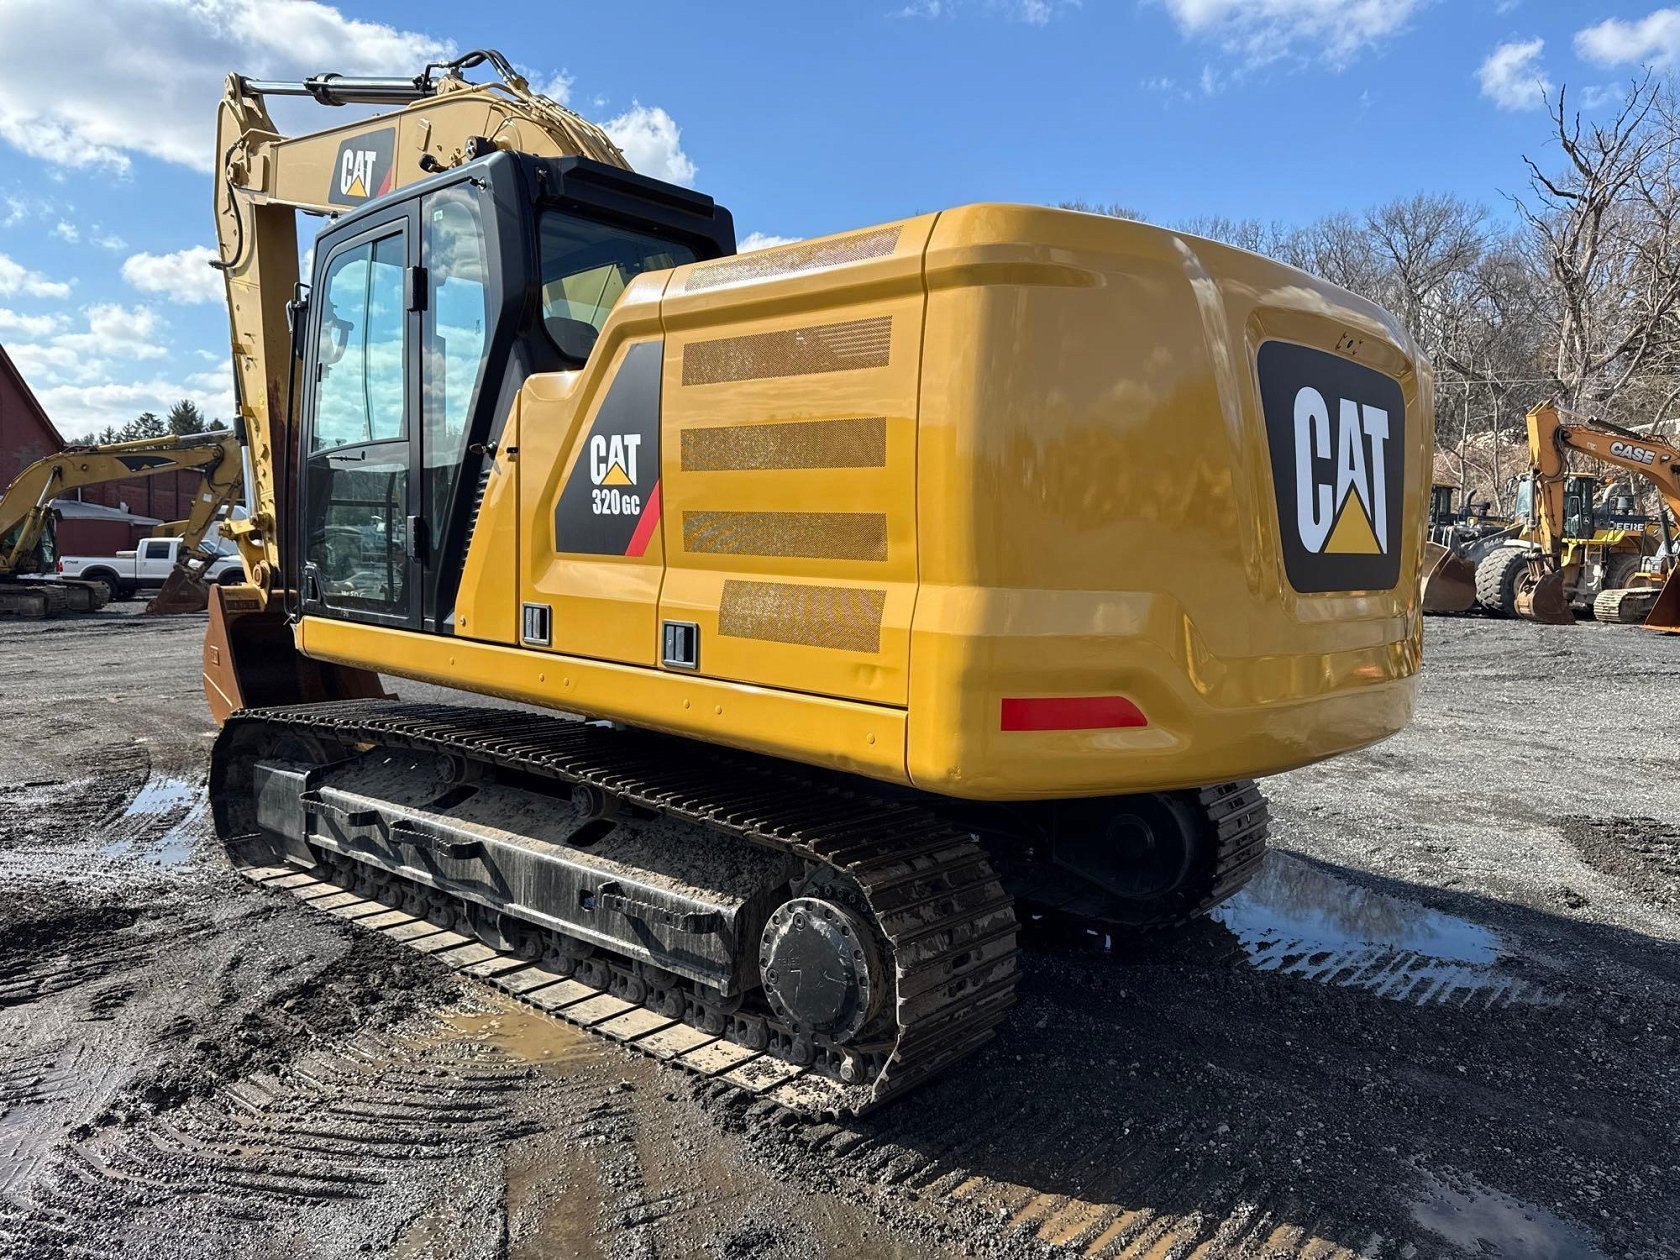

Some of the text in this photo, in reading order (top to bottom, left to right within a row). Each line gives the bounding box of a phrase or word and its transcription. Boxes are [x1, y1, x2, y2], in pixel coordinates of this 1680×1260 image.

[340, 149, 377, 198] CAT
[590, 434, 641, 486] CAT
[1293, 386, 1389, 555] CAT
[1610, 441, 1656, 465] CASE
[592, 488, 641, 515] 320 GC
[1609, 520, 1645, 532] DEERE
